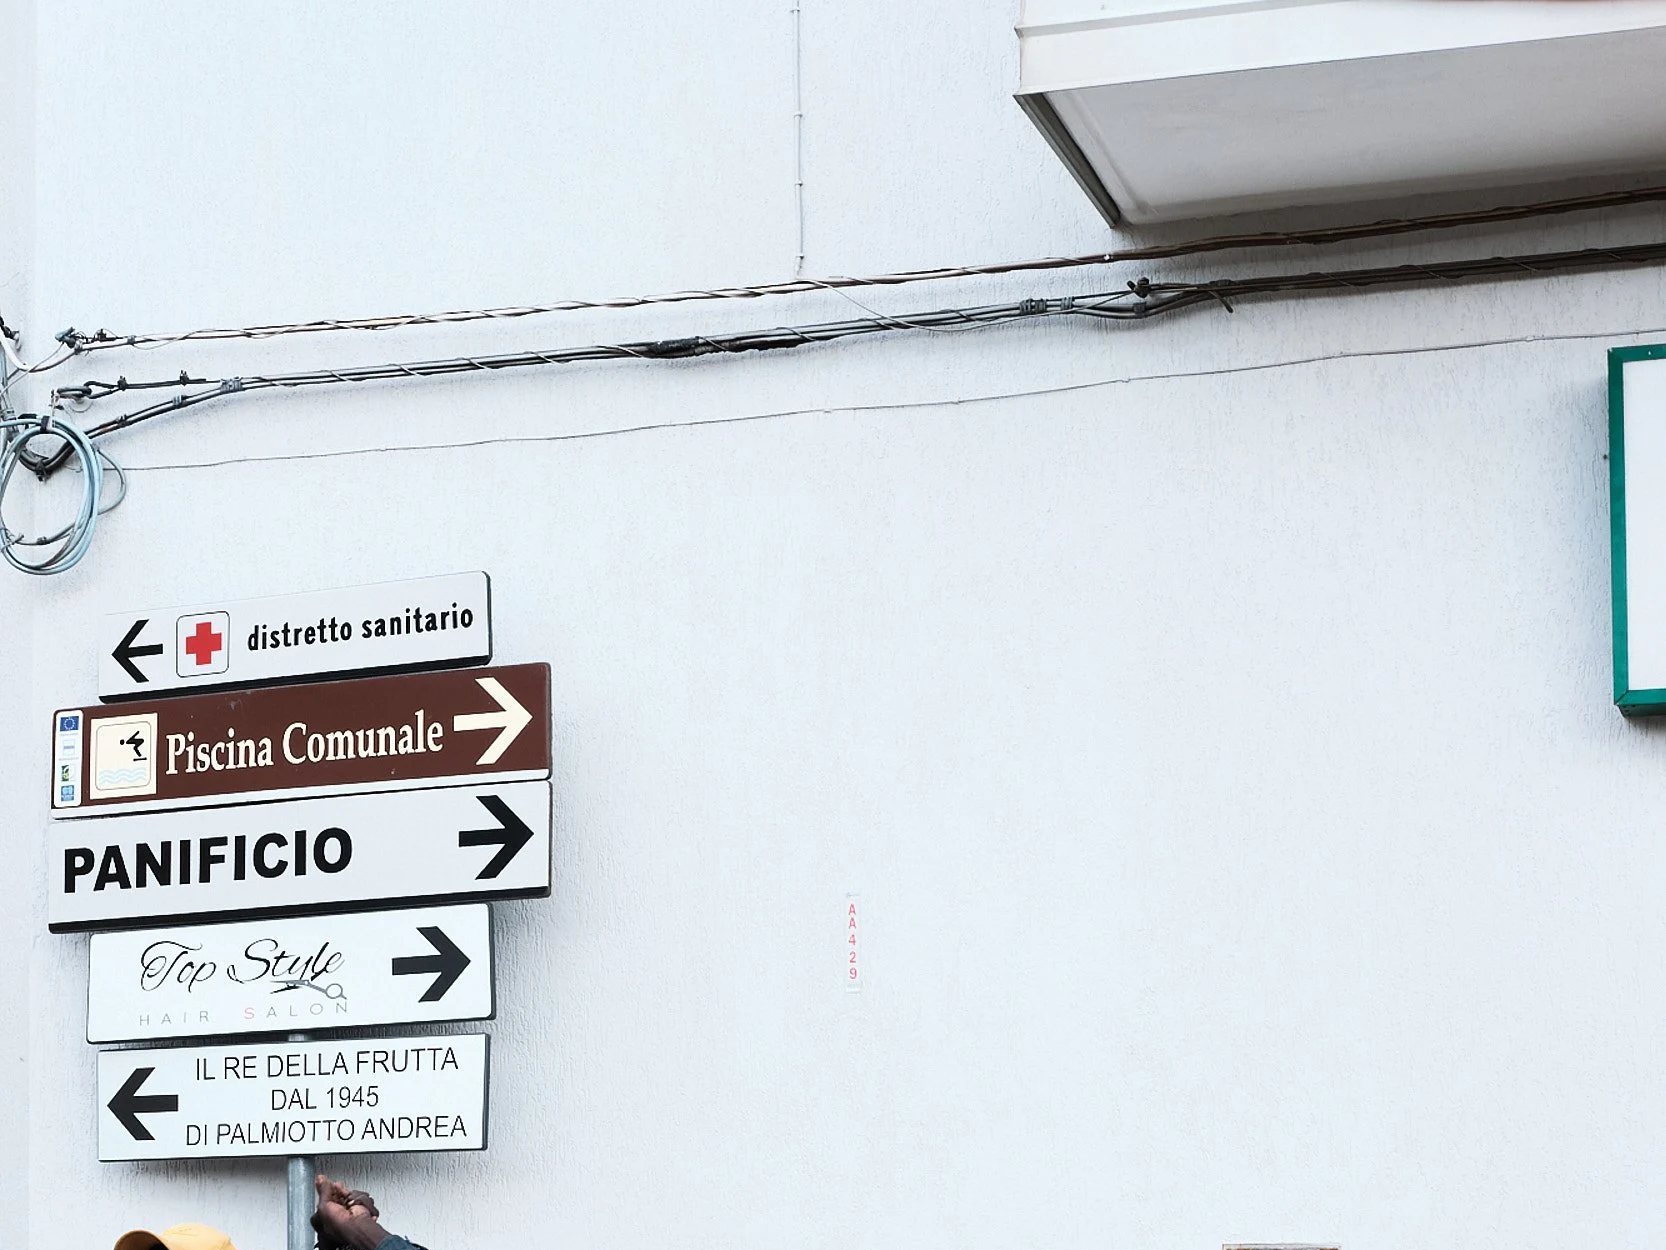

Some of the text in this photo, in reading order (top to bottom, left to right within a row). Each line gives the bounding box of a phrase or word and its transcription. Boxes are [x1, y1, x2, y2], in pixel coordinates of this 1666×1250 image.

[247, 602, 474, 651] distretto sanitario
[166, 710, 444, 775] Piscina Comunale
[63, 827, 353, 893] PANIFICIO
[140, 938, 346, 993] Top Style
[139, 1001, 348, 1027] HAIR SALON
[196, 1046, 459, 1081] IL RE DELLA FRUTTA
[271, 1085, 379, 1111] DAL 1945
[186, 1115, 467, 1147] DI PALMIOTTO ANDREA
